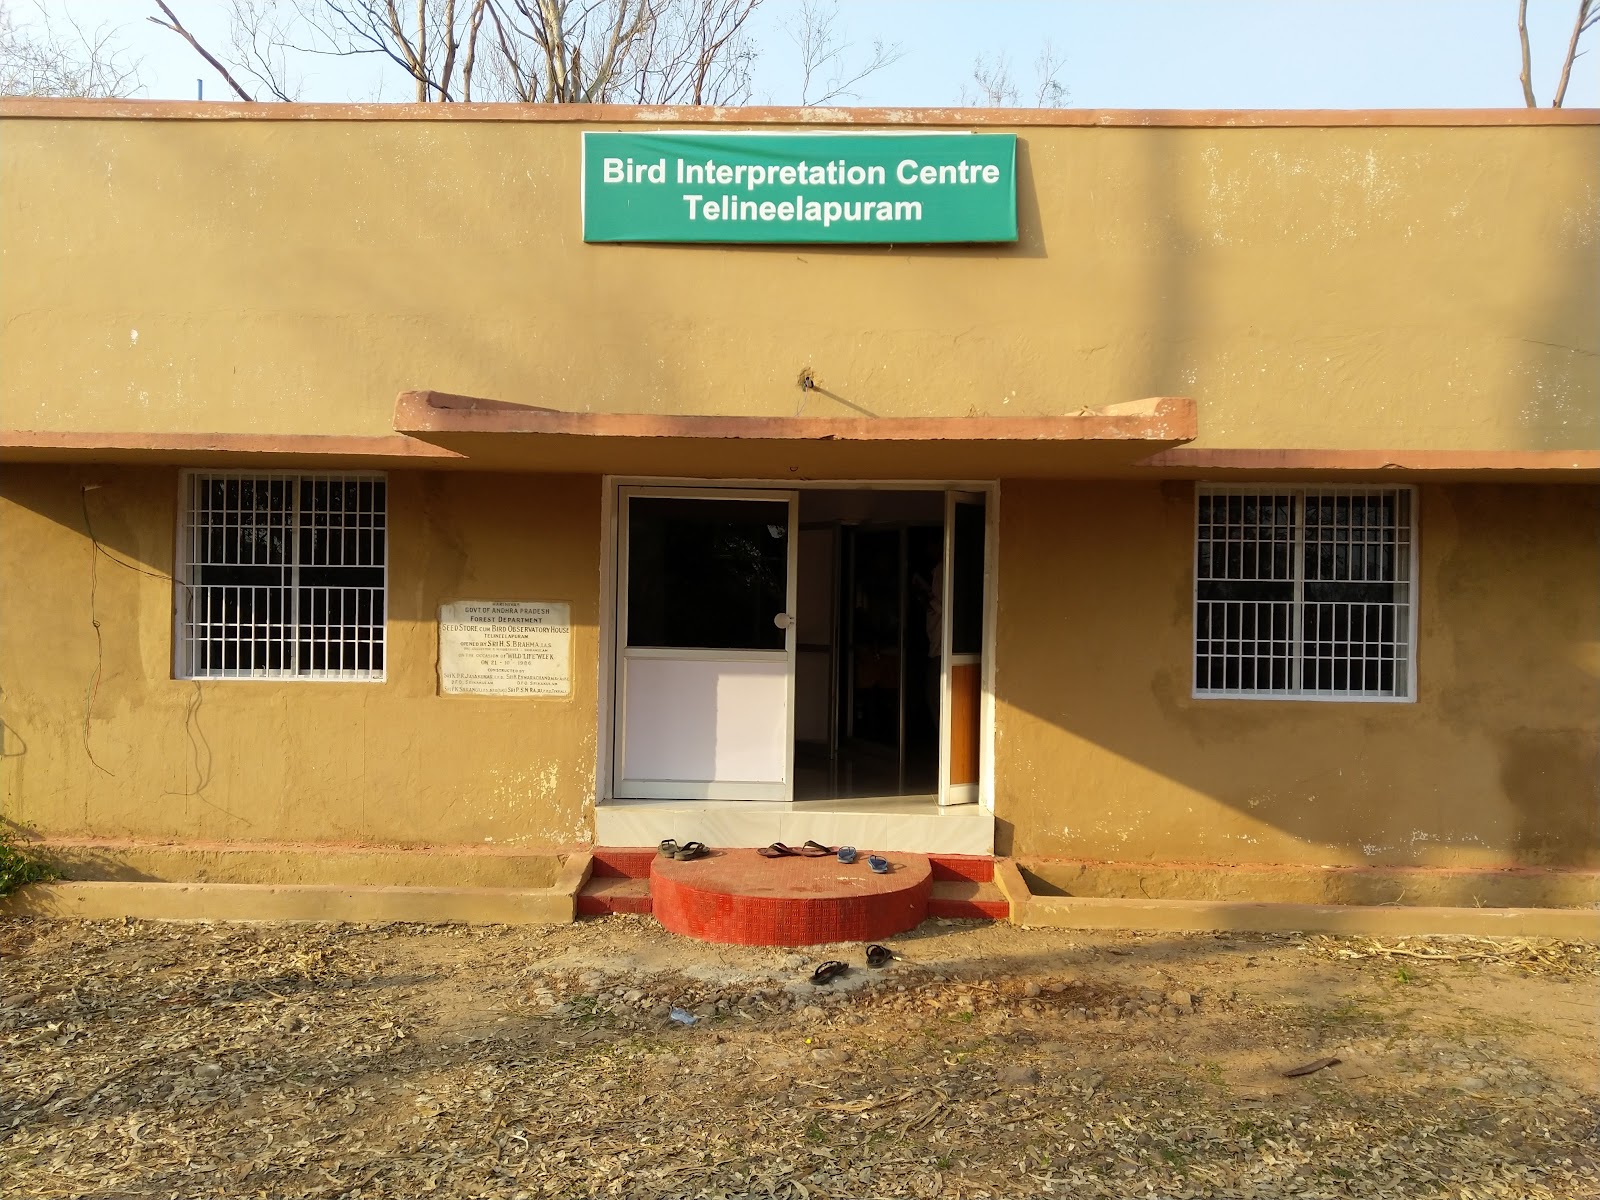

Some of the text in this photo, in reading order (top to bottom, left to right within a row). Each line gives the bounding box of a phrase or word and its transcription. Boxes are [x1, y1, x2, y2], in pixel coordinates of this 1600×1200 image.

[602, 158, 1000, 190] Bird Interpretation Centre
[683, 195, 922, 227] Telineelapuram
[492, 624, 507, 632] BIRD
[508, 625, 550, 633] OBSERVATORY
[551, 626, 569, 634] HOUSE
